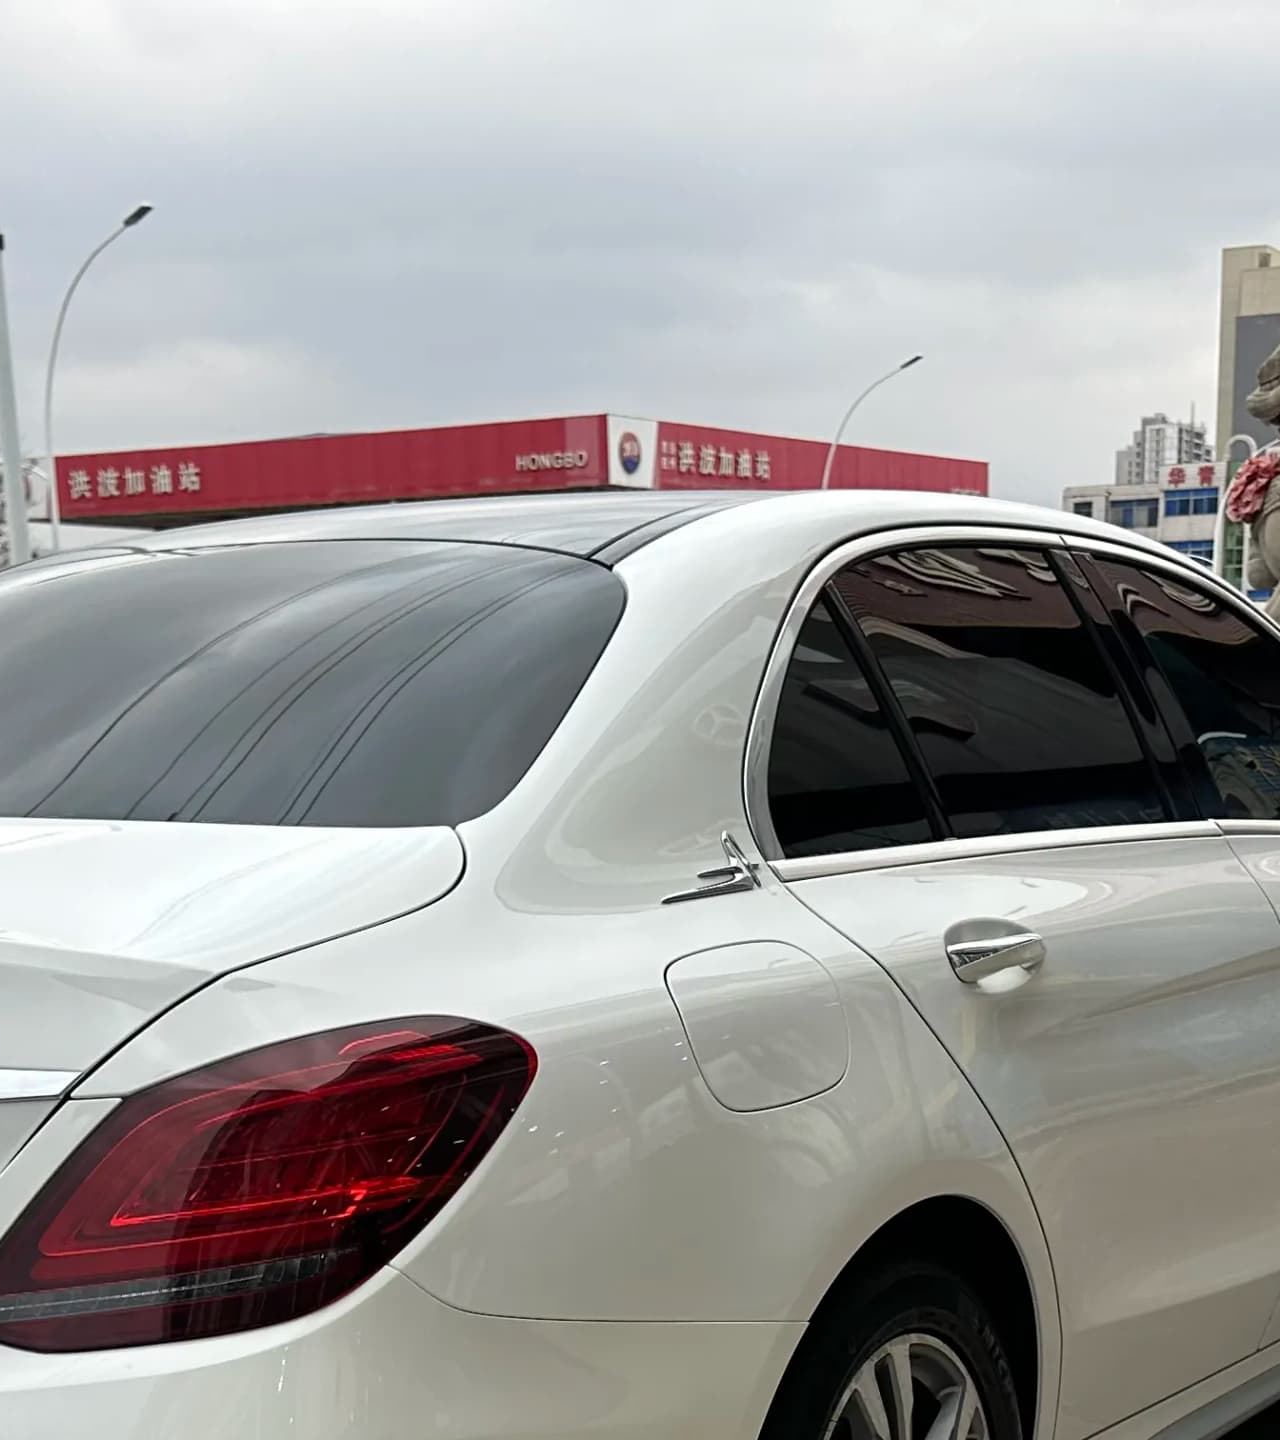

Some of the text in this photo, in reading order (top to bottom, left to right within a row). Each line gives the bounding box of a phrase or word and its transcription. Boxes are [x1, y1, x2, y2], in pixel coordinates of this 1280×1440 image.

[515, 450, 588, 471] HONGBO
[678, 440, 771, 480] 洪波加油站
[68, 462, 201, 499] 洪波加油站
